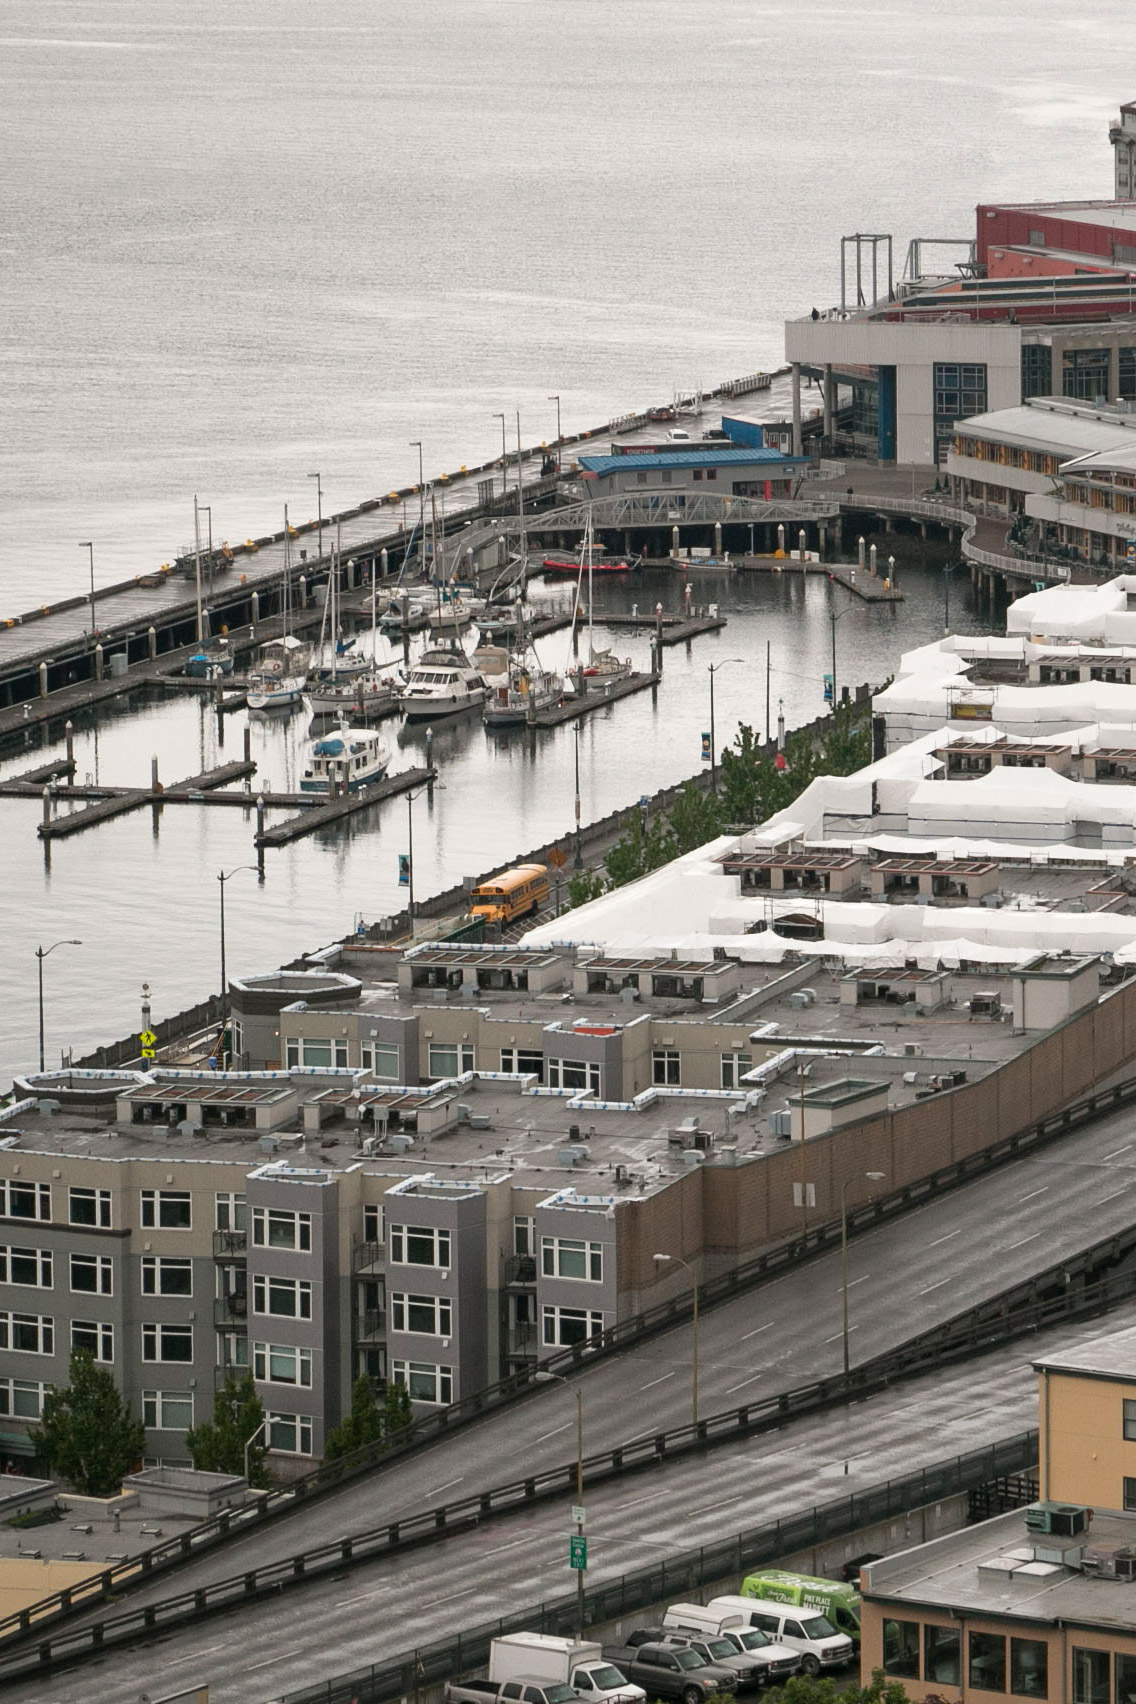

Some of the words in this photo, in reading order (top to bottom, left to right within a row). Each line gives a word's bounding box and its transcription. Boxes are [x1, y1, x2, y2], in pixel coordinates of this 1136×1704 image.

[803, 1594, 815, 1602] PIKE
[815, 1595, 831, 1605] PLACE
[803, 1601, 830, 1616] MARKET
